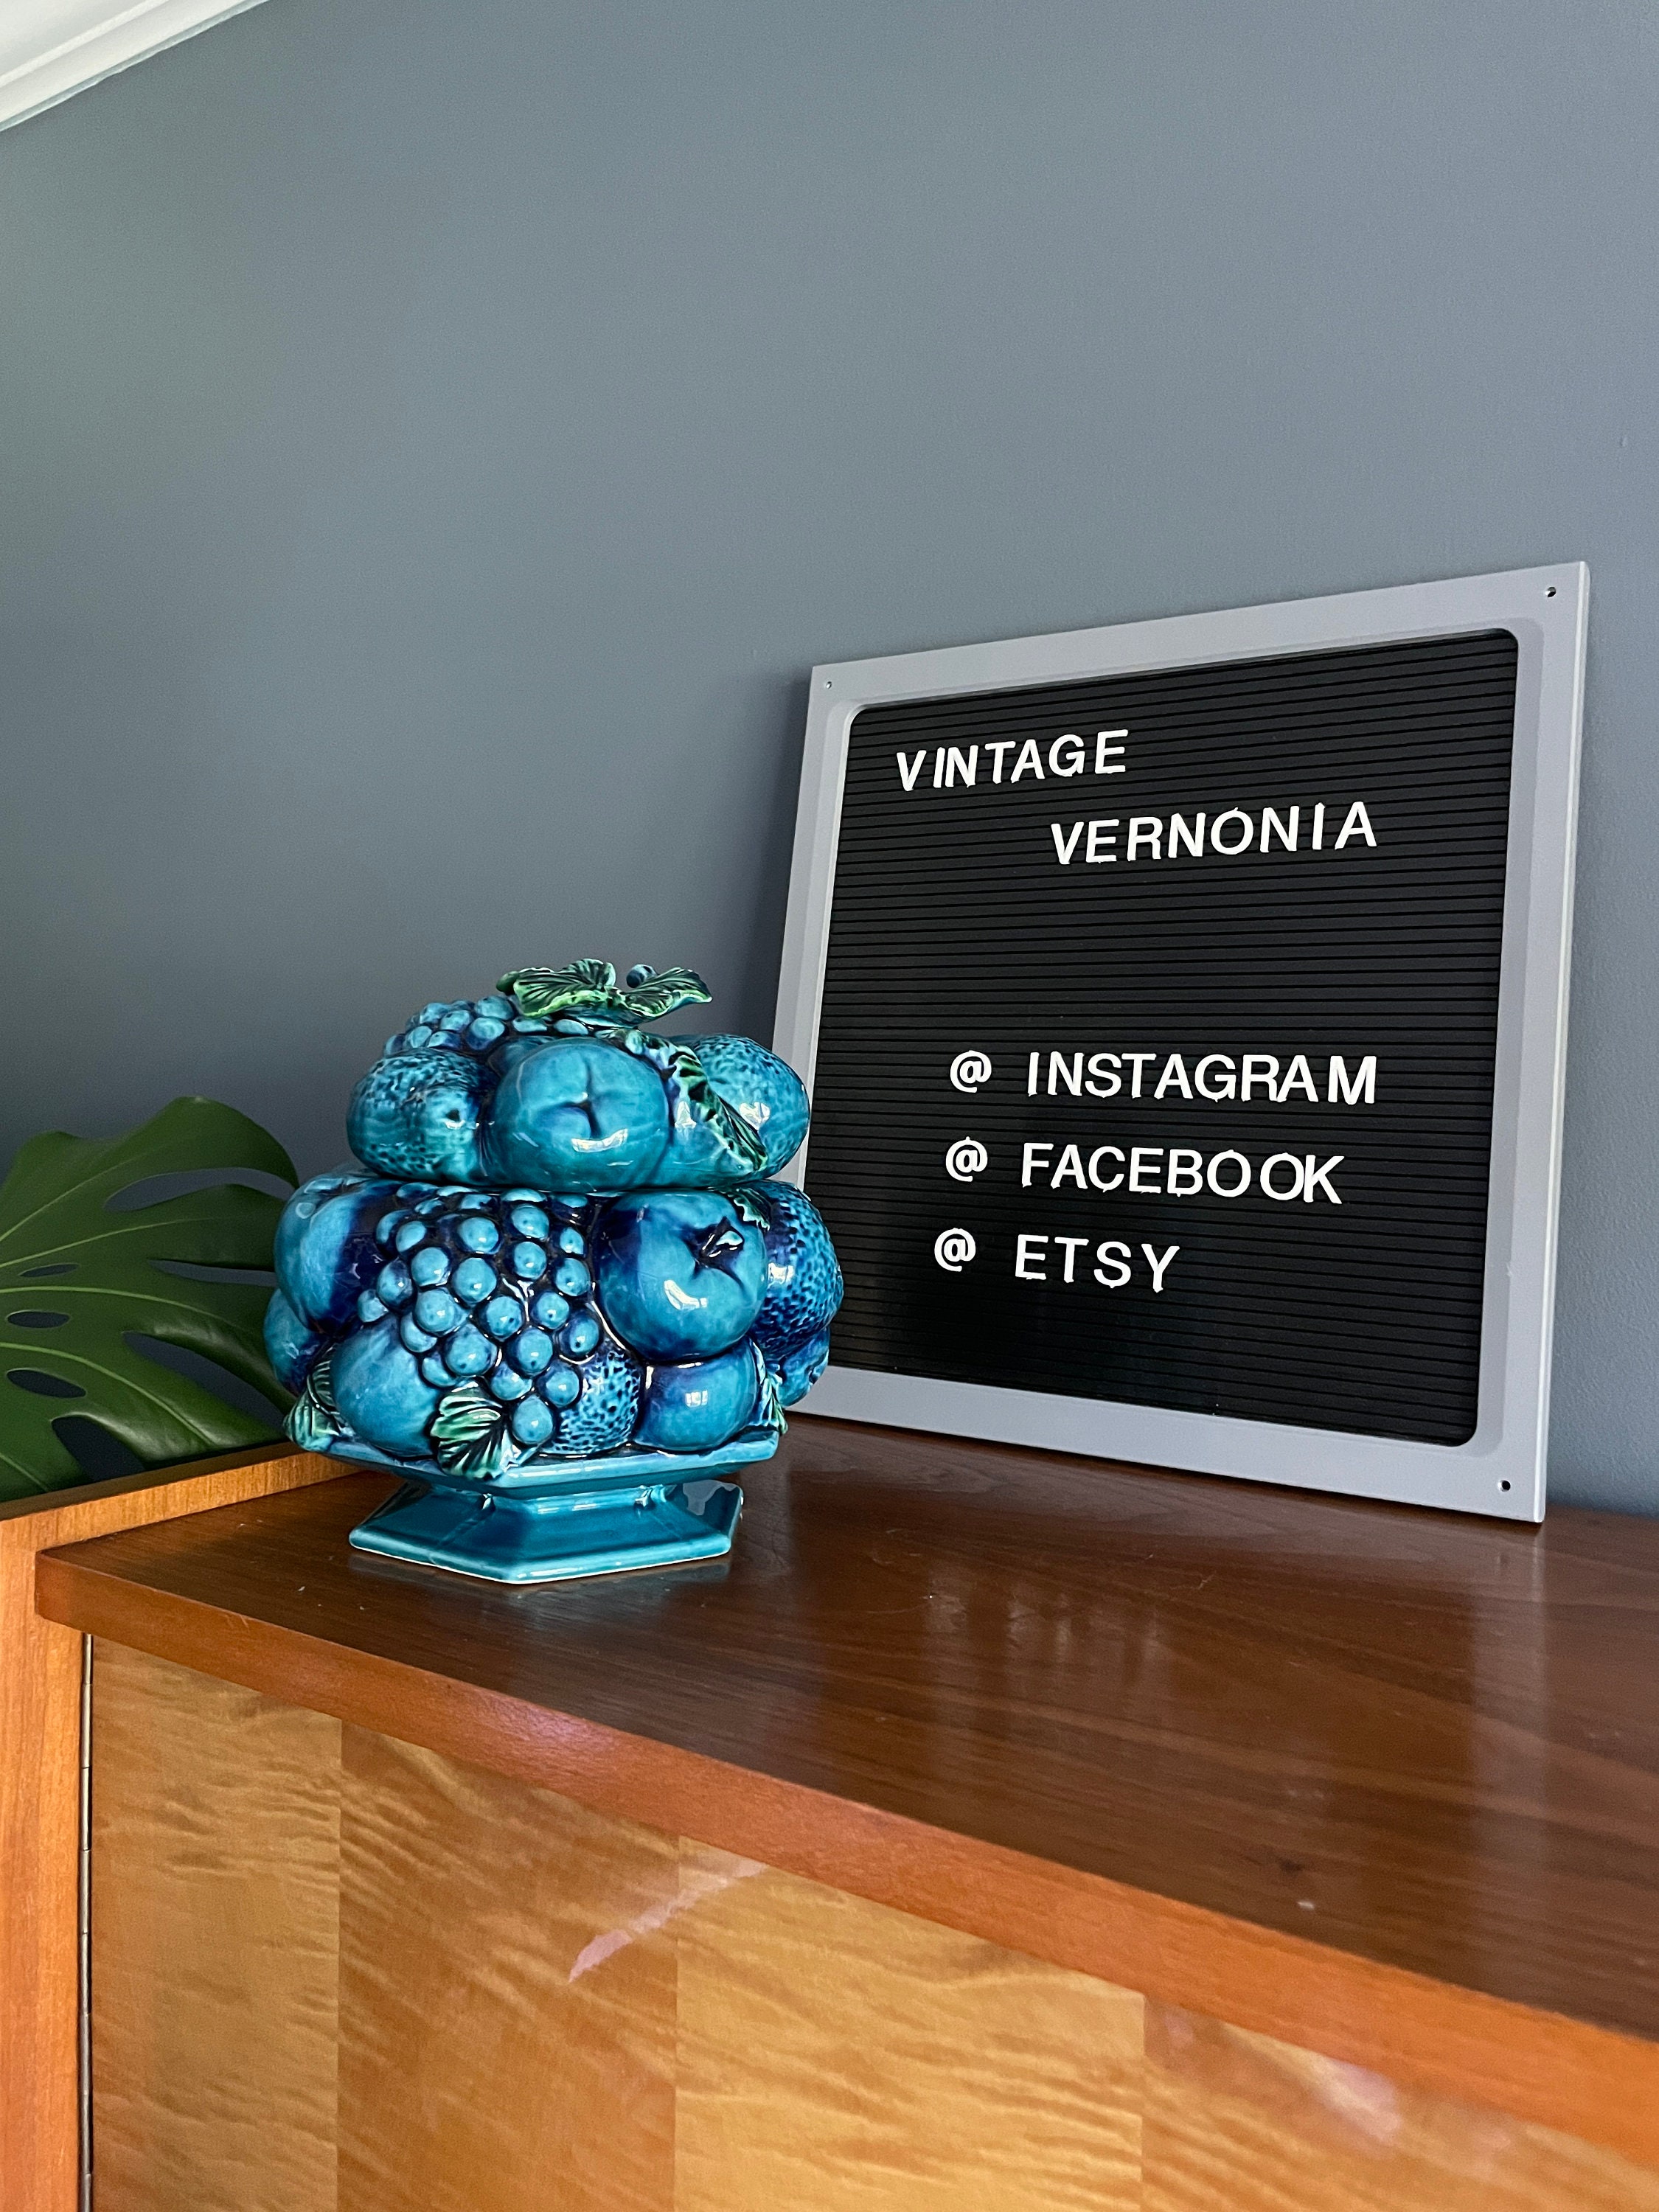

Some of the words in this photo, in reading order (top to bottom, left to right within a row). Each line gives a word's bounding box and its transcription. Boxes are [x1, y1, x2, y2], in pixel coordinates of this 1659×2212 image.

[896, 728, 1129, 792] VINTAGE
[1051, 801, 1377, 866] VERNONIA
[950, 1049, 992, 1093] @
[1027, 1051, 1377, 1105] INSTAGRAM
[945, 1135, 988, 1183] @
[1021, 1143, 1345, 1205] FACEBOOK
[933, 1227, 976, 1273] @
[1015, 1234, 1180, 1293] ETSY
